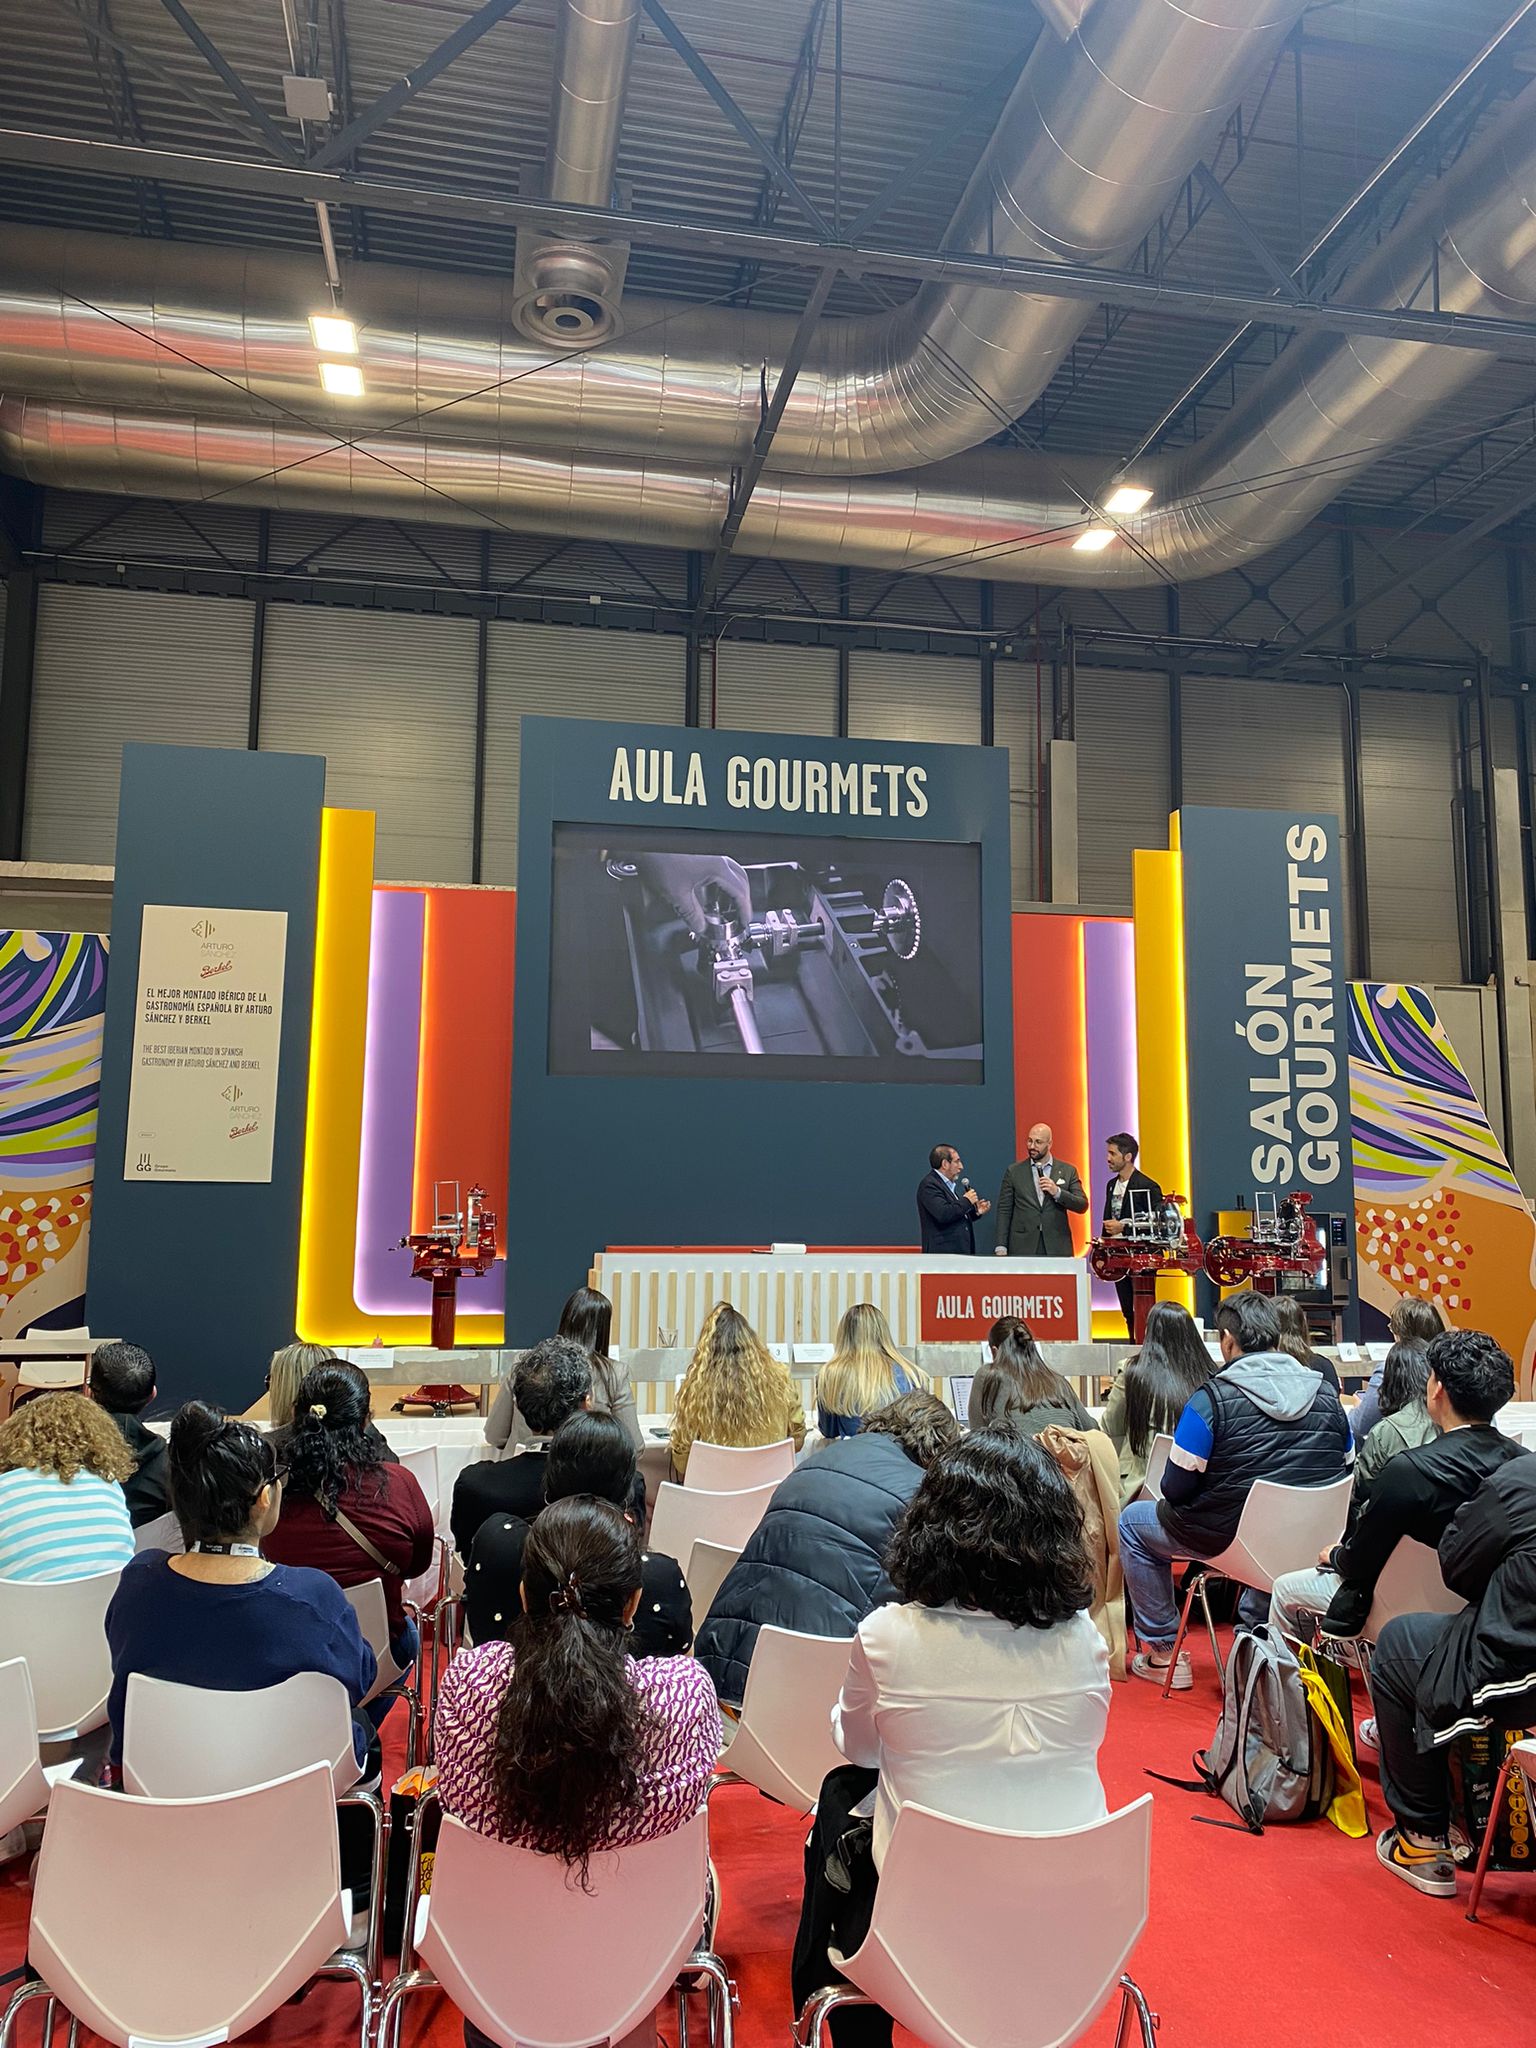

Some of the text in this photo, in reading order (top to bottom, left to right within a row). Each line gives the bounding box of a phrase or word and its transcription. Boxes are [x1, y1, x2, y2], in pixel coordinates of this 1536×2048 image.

[609, 747, 928, 818] AULA GOURMETS
[200, 942, 234, 950] ARTURO
[147, 988, 267, 1002] EL MEJOR MONTADO IBÉRICO DE LA
[145, 1000, 273, 1015] GASTRONOMÍA ESPAÑOLA BY ARTURO
[1286, 824, 1341, 1185] GOURMETS
[144, 1012, 212, 1025] SÁNCHEZ Y BERKEL
[143, 1045, 244, 1056] THE BEST IBERIAN MONTADO IN SPANISH
[142, 1057, 176, 1067] GASTRONOMY
[177, 1058, 184, 1067] BY
[184, 1059, 204, 1068] ARTURO
[229, 1060, 240, 1069] AND
[241, 1060, 260, 1070] BERKEL
[1235, 964, 1294, 1185] SALÓN
[936, 1295, 1064, 1319] AULA GOURMETS
